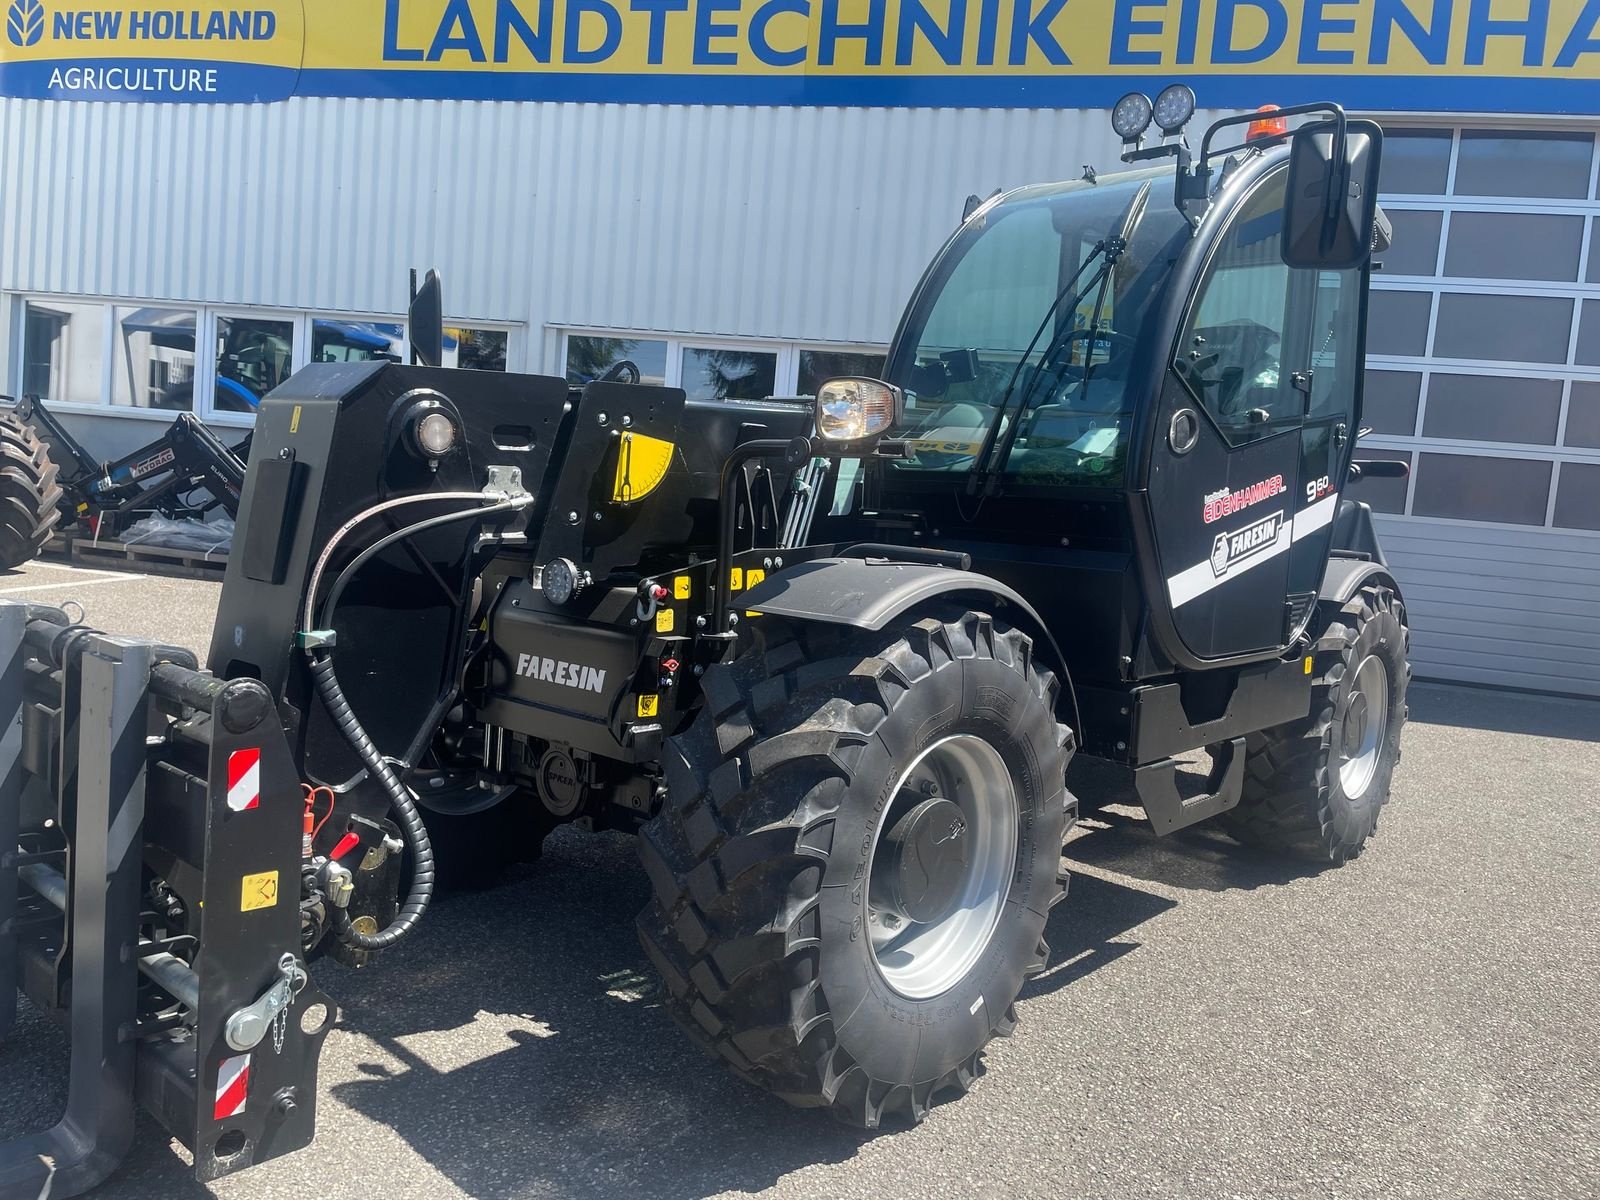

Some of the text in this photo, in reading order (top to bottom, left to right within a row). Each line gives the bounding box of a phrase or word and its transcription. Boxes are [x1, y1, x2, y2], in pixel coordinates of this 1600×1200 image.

[53, 10, 276, 40] NEW HOLLAND
[382, 0, 1074, 67] LANDTECHNIK
[48, 67, 218, 92] AGRICULTURE
[137, 454, 173, 475] HYDRAC
[1203, 474, 1283, 524] EIDENHAMMER
[1306, 475, 1329, 503] 960
[1230, 518, 1277, 557] FARESIN
[515, 652, 607, 694] FARESIN
[549, 771, 574, 787] SPICER
